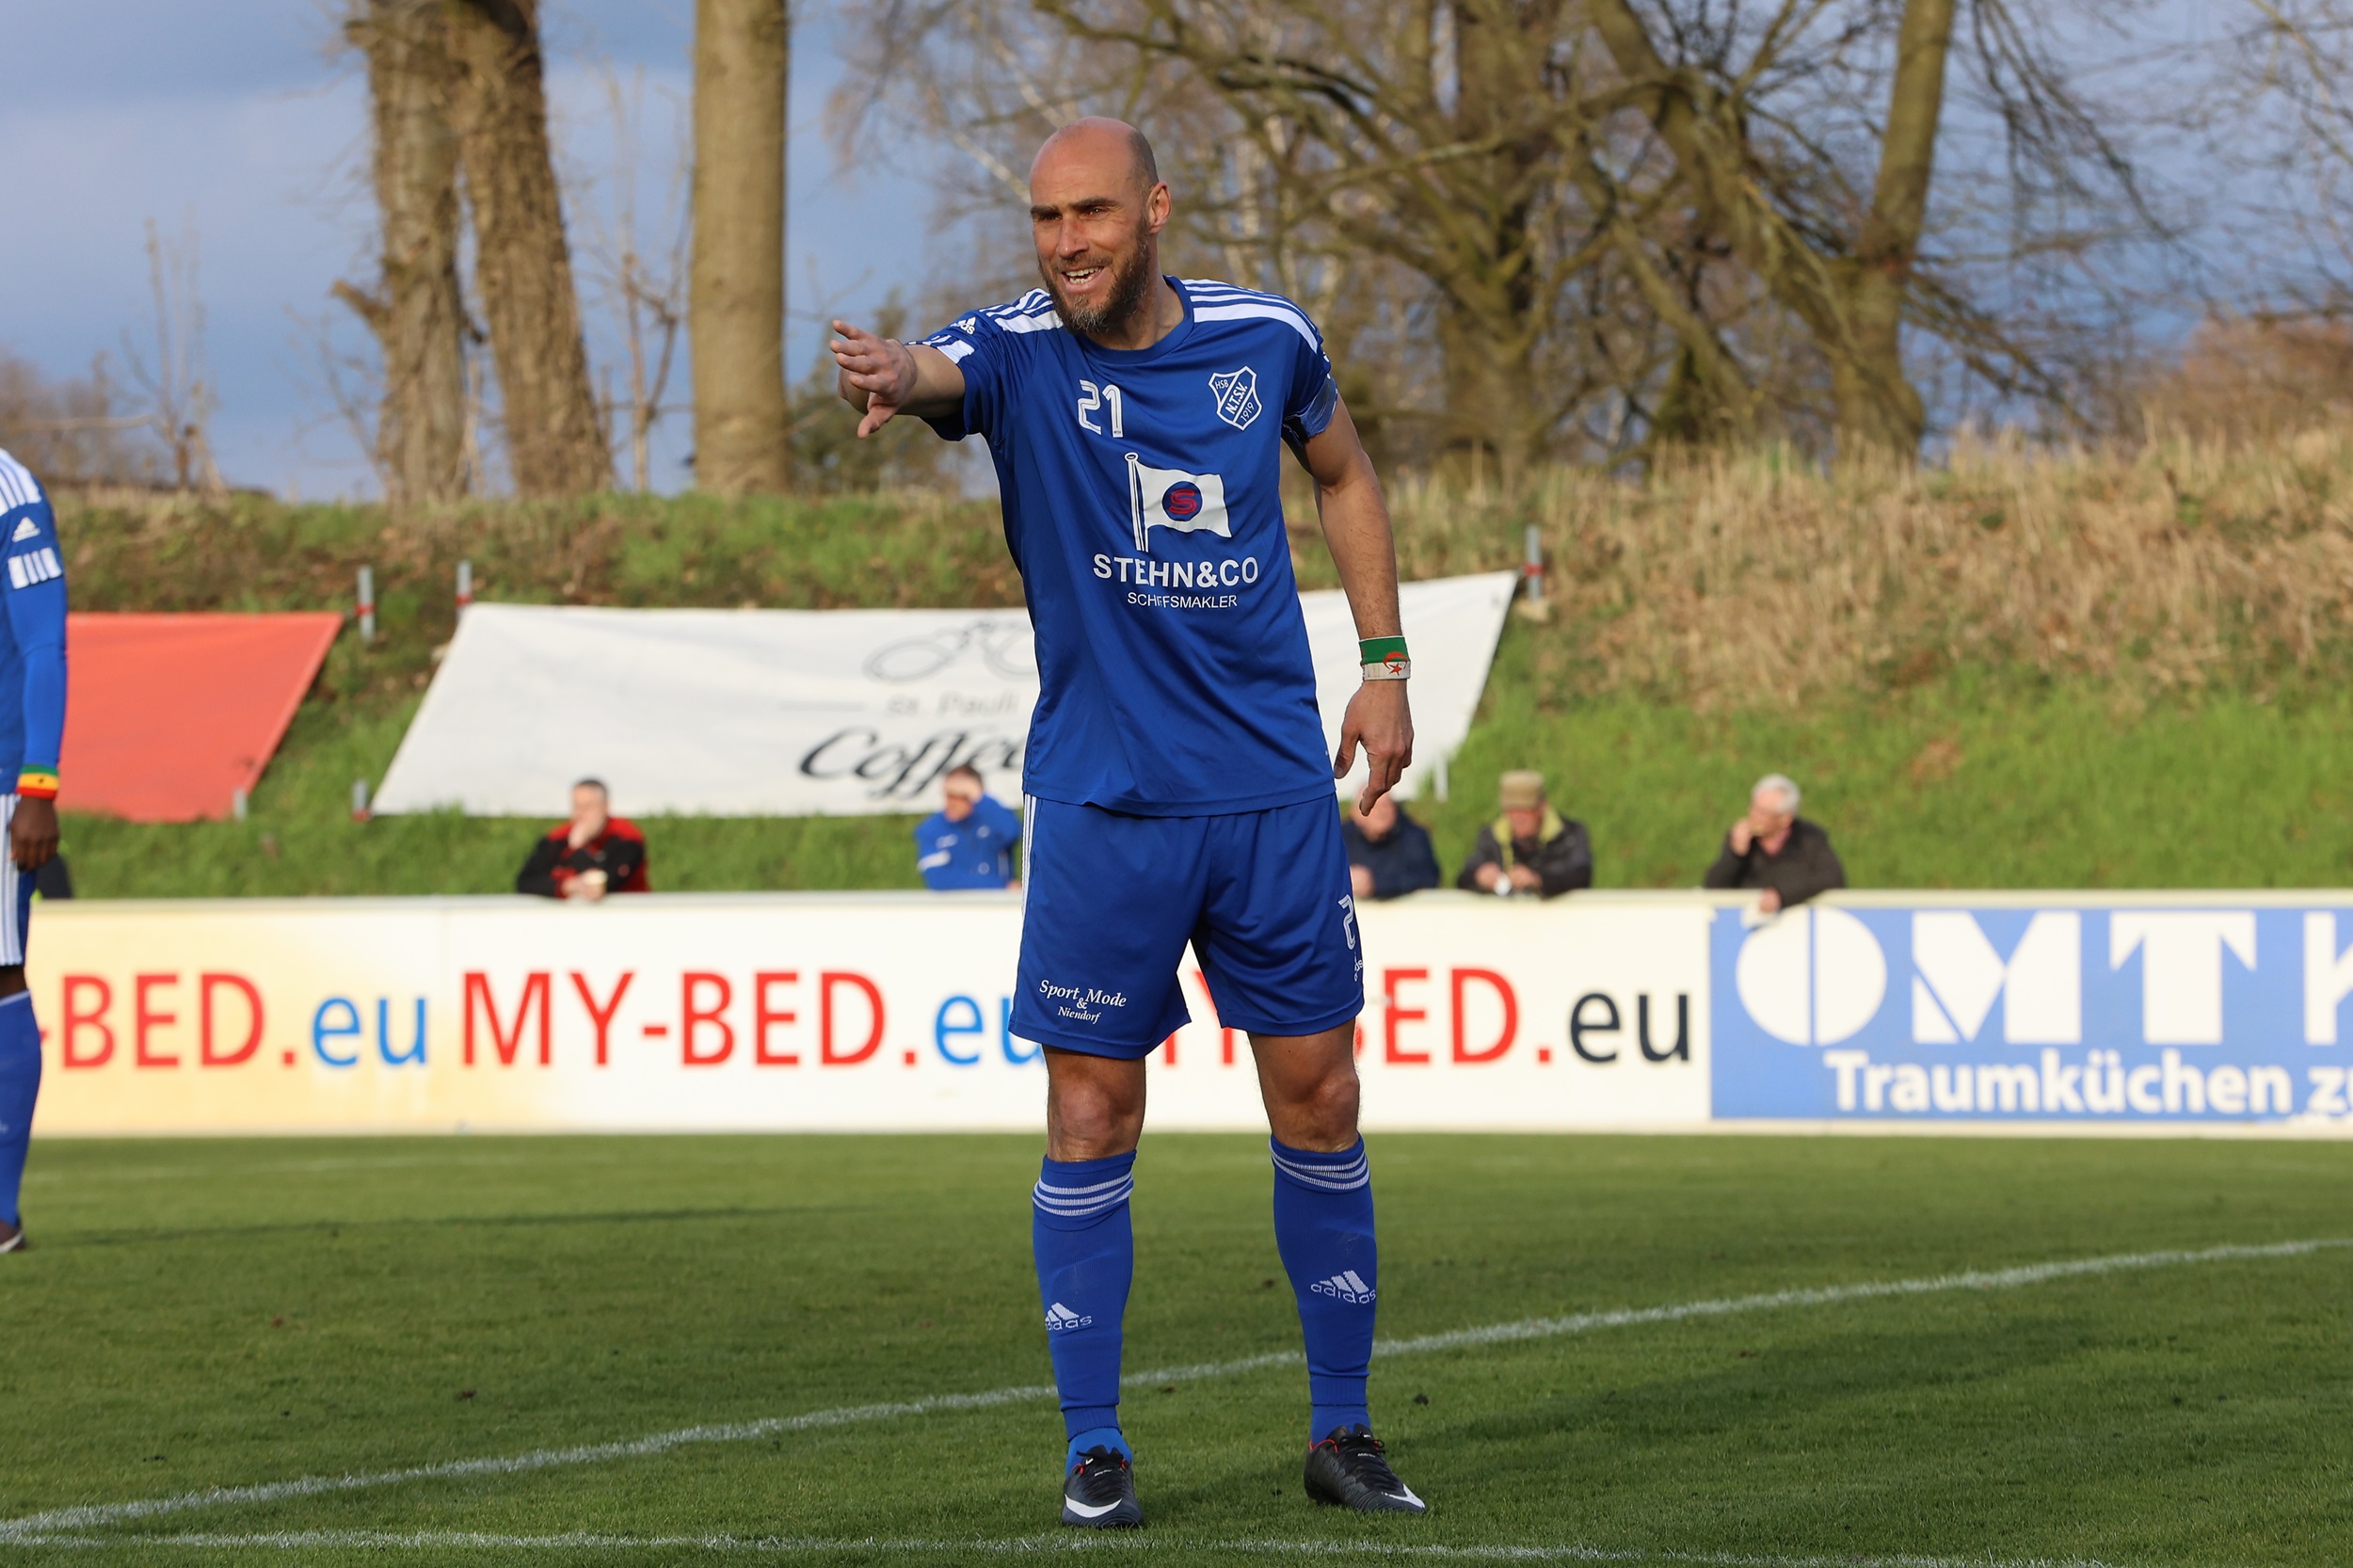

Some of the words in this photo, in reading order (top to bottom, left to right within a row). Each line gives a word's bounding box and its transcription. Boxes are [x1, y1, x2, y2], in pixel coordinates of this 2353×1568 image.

[1215, 379, 1229, 389] HSB
[1078, 379, 1123, 438] 21
[1241, 402, 1254, 422] 1919
[1093, 553, 1258, 587] STEHN&CO
[1039, 980, 1080, 1000] Sport
[1076, 998, 1088, 1009] &
[1085, 988, 1127, 1007] Mode
[1058, 1006, 1101, 1024] Niendorf
[1823, 1047, 2293, 1114] Traumküchen
[2307, 1064, 2353, 1112] z
[1310, 1283, 1376, 1304] adidas
